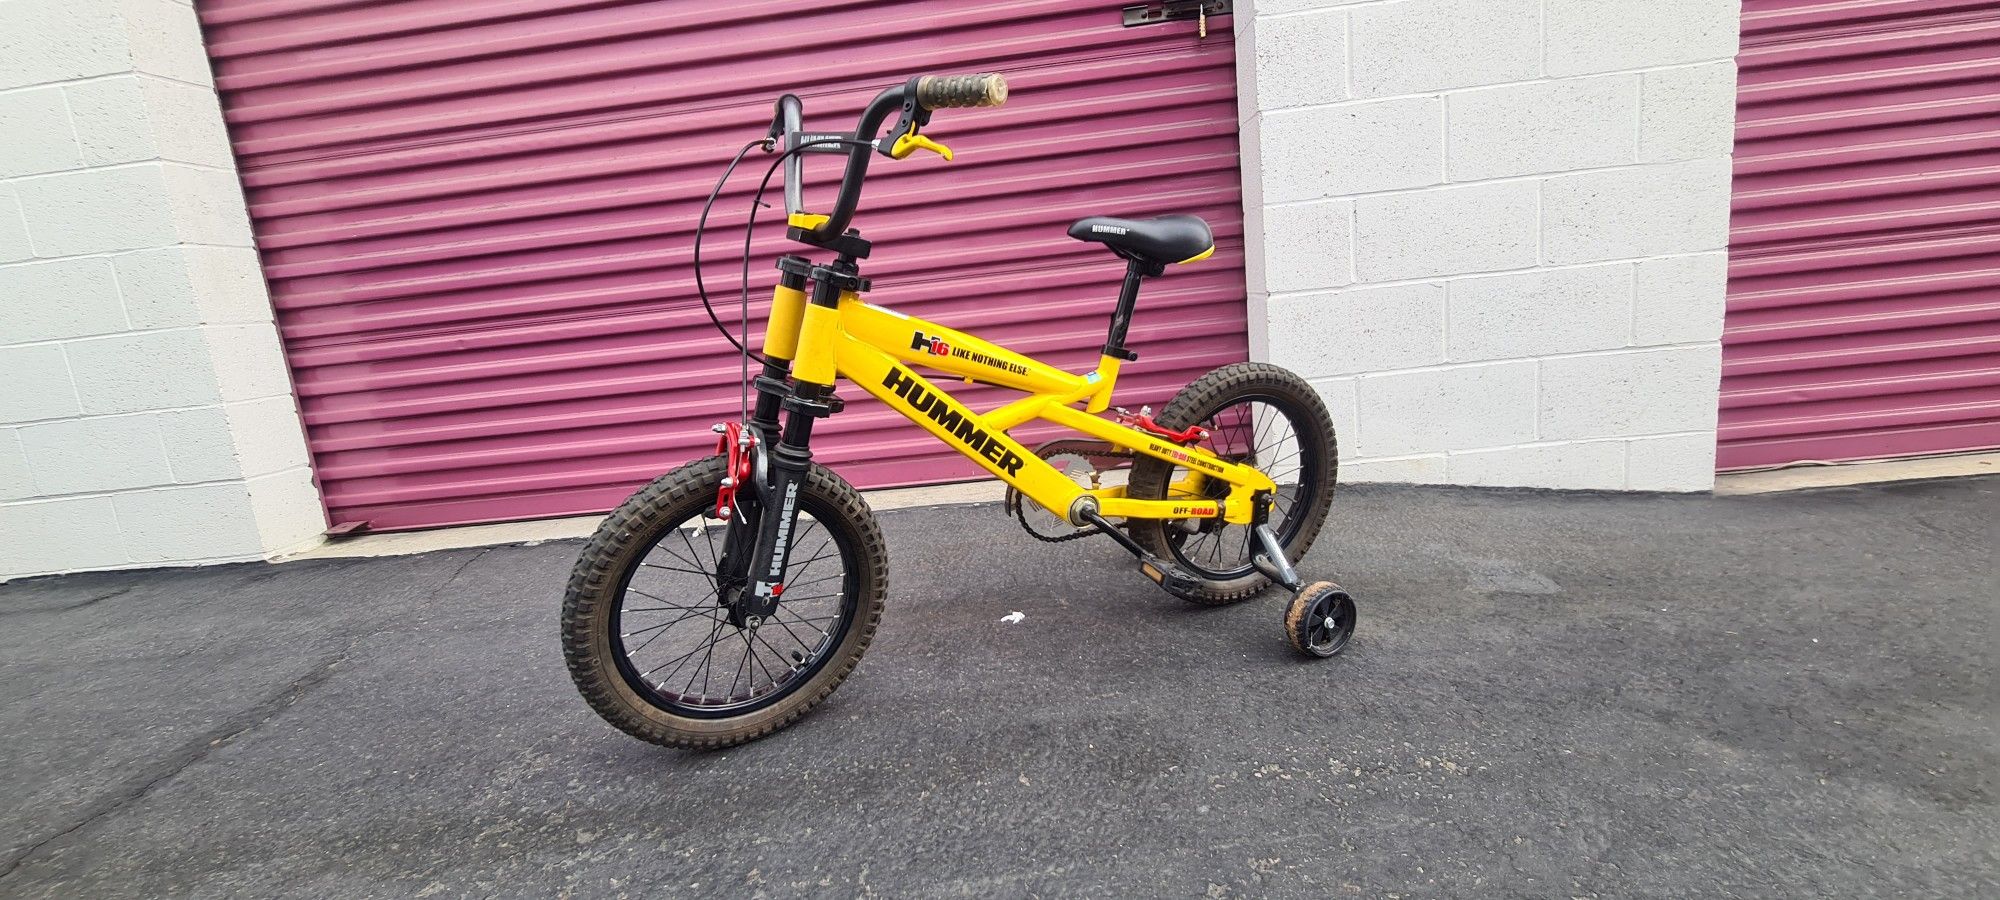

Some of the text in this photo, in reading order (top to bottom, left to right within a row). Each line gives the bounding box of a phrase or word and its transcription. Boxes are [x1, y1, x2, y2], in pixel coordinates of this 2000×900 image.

[1092, 224, 1126, 235] HUMMER
[952, 346, 970, 360] LIKE
[971, 353, 1008, 370] NOTHING
[881, 366, 1025, 479] HUMMER
[1173, 506, 1214, 516] OFF-ROAD
[769, 482, 799, 576] HUMMER
